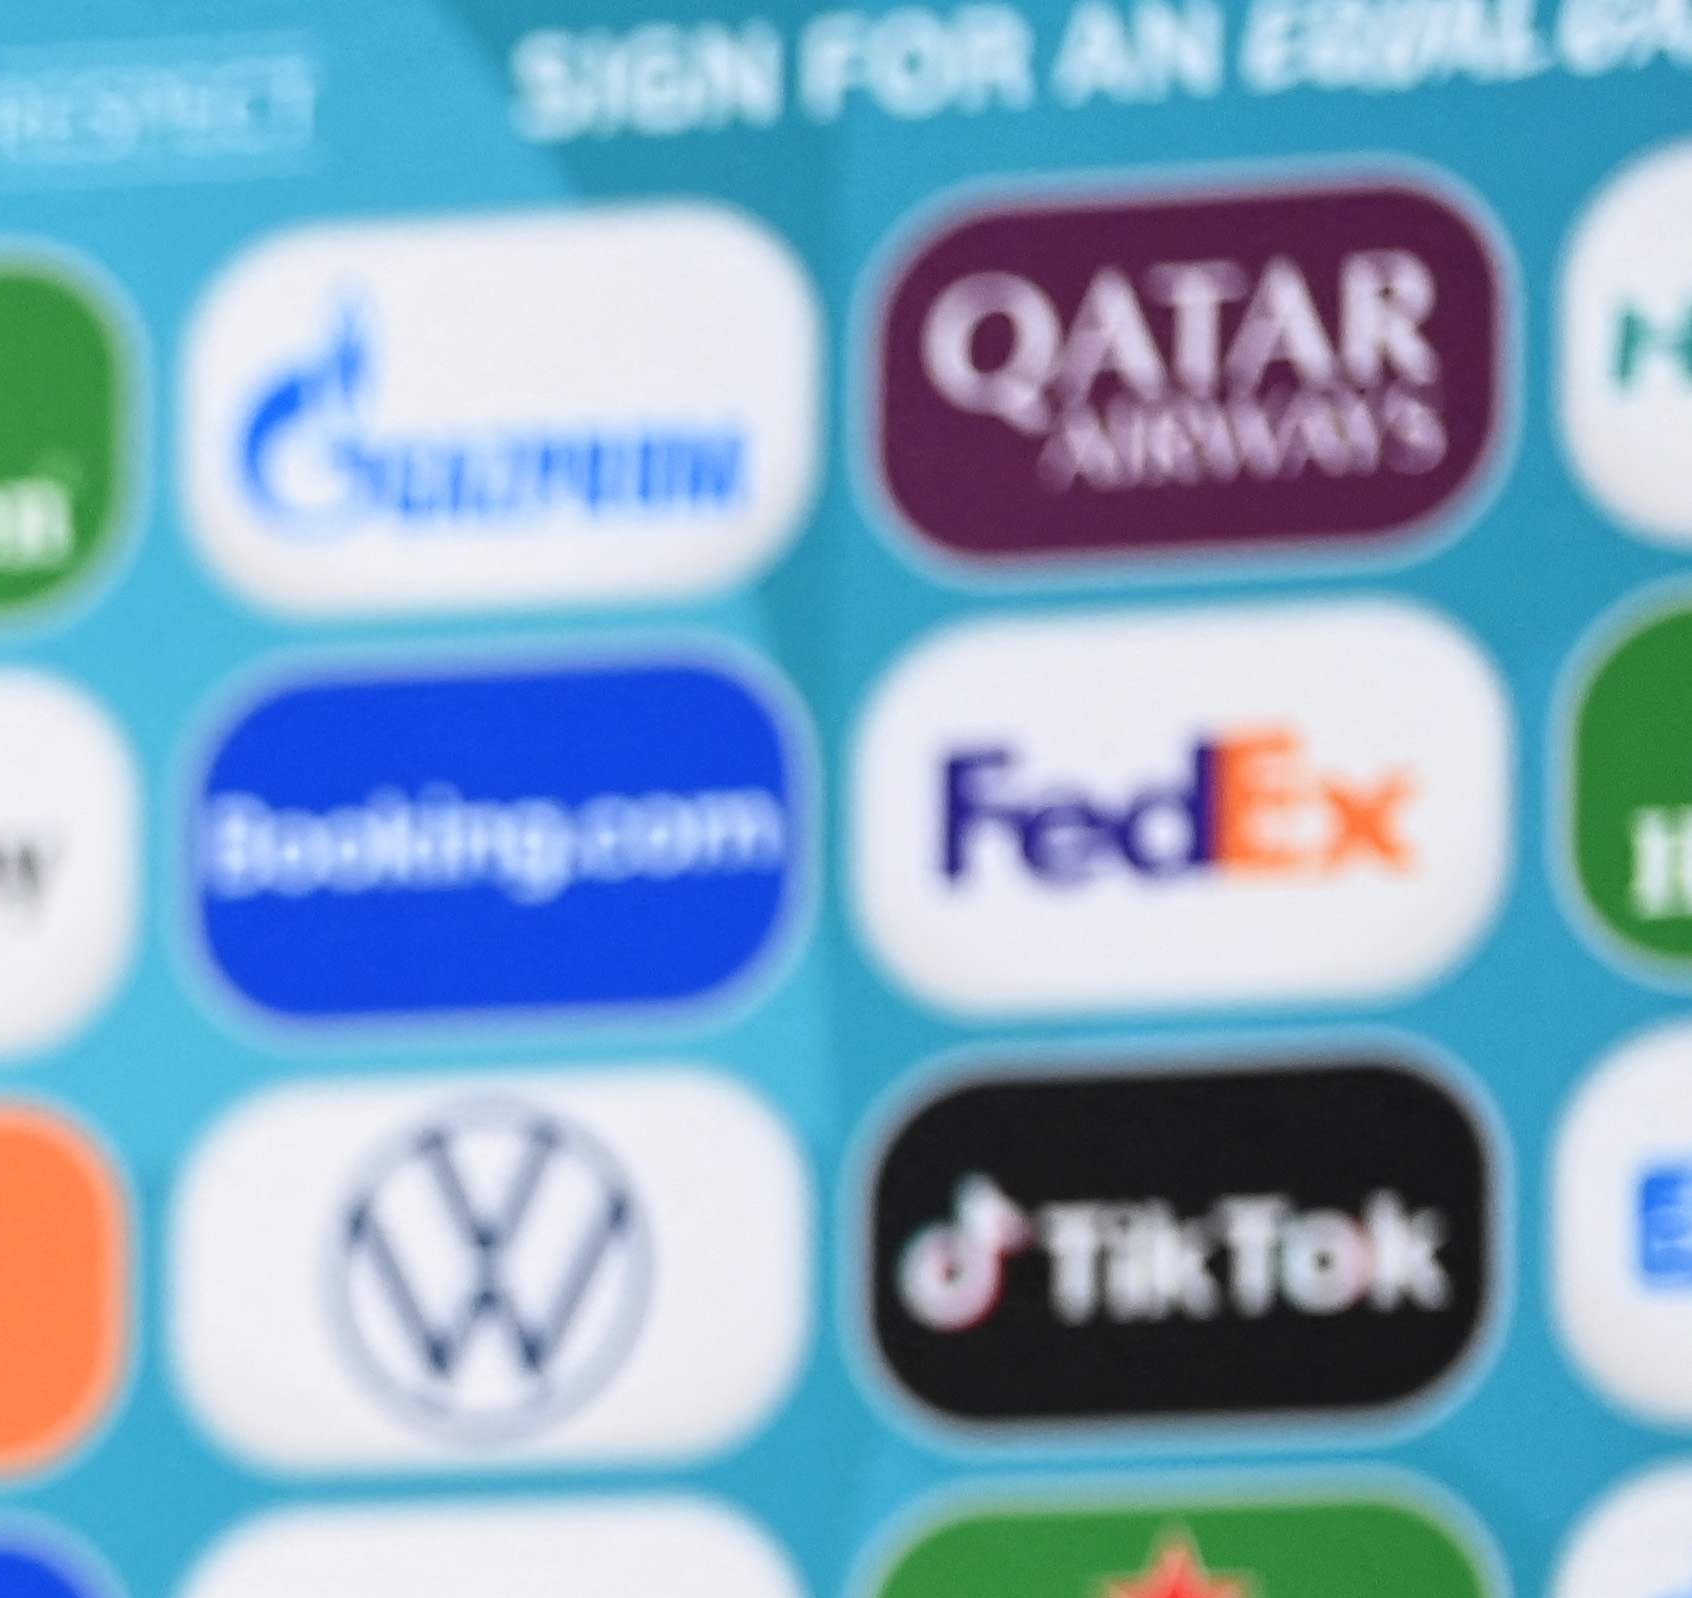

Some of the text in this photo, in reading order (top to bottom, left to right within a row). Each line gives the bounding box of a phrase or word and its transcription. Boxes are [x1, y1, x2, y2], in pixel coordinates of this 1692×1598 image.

[512, 22, 783, 142] SIGN
[802, 5, 1034, 120] FOR
[1057, 0, 1213, 108] AN
[920, 248, 1438, 432] QATAR
[1040, 390, 1448, 494] AIRWAYS
[206, 778, 786, 904] Booking.com
[938, 722, 1418, 890] FedEx
[1040, 1188, 1456, 1325] TikTok
